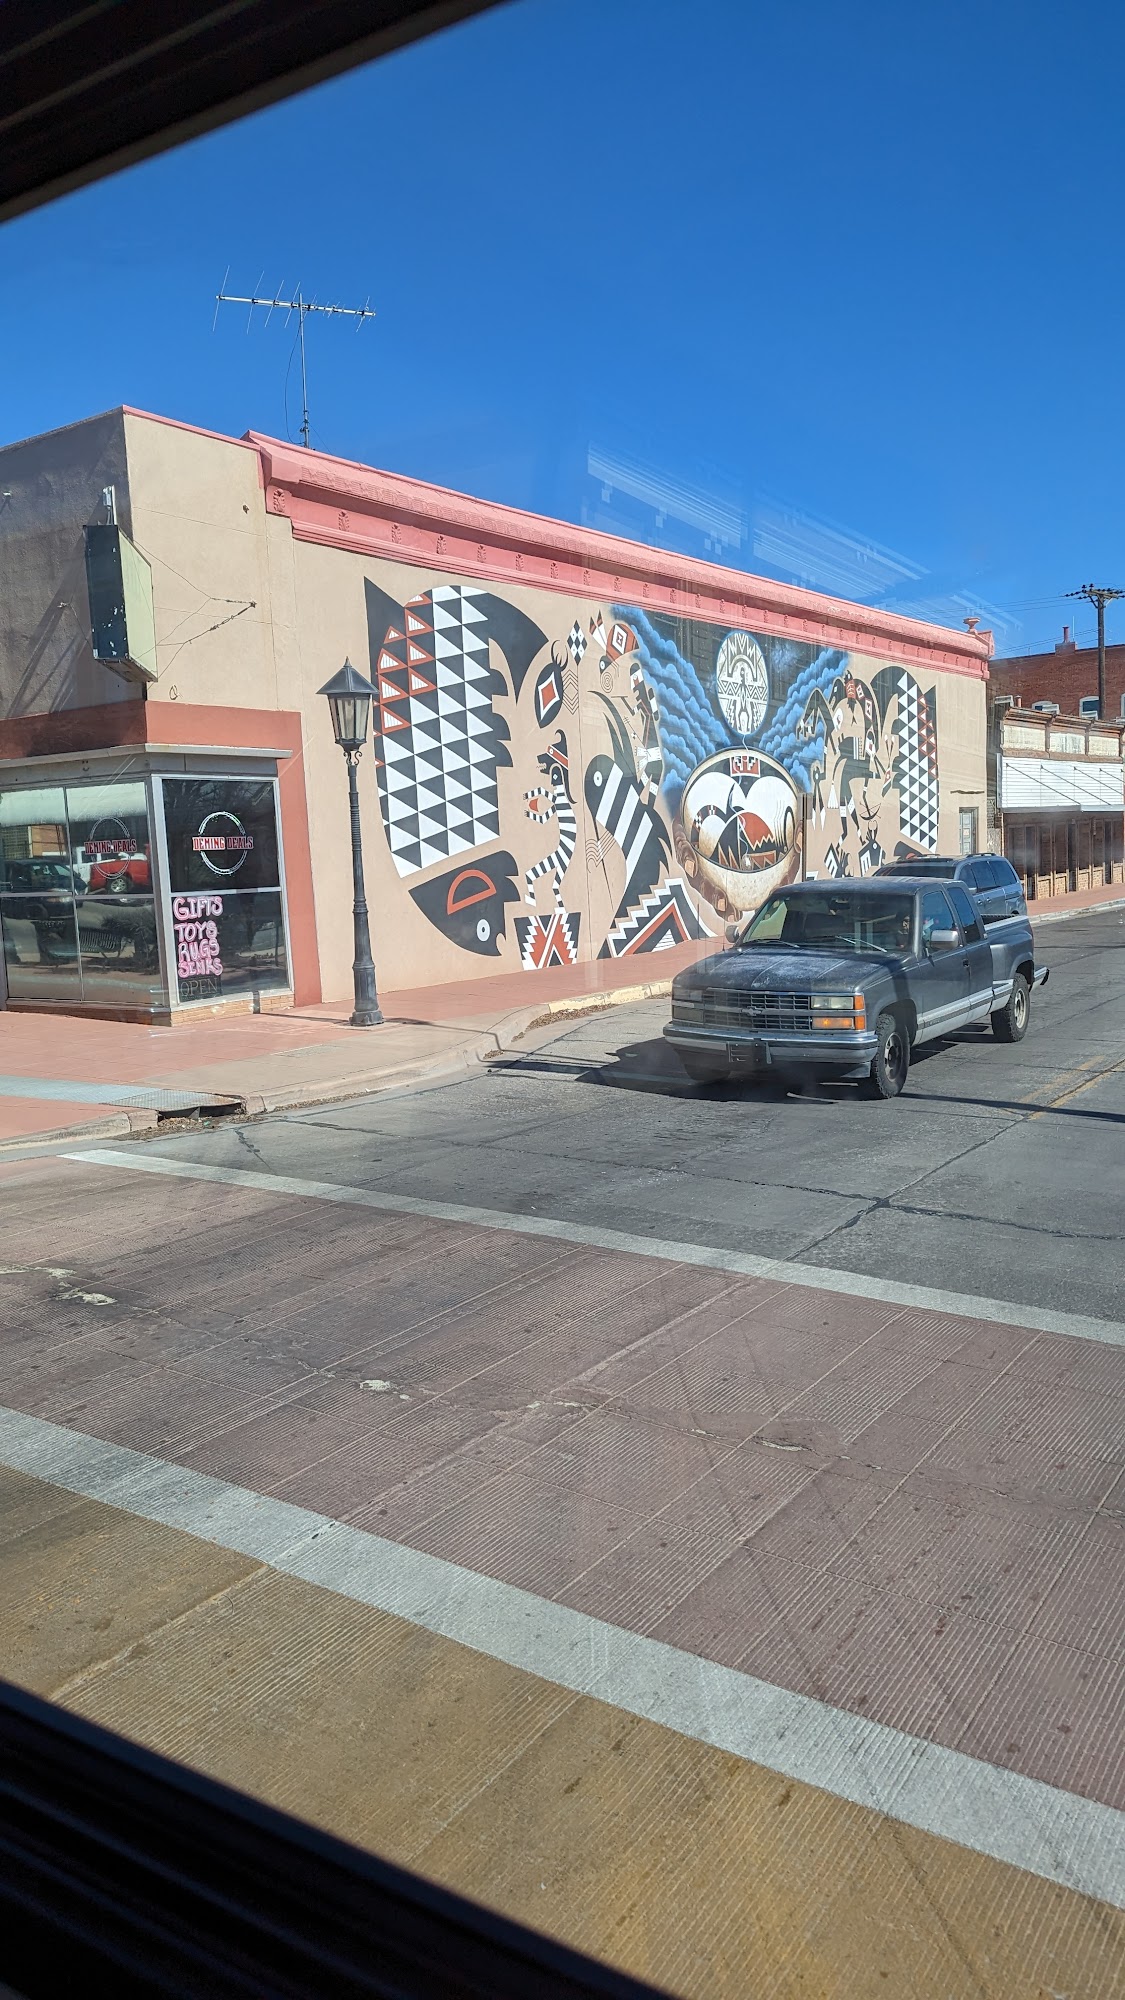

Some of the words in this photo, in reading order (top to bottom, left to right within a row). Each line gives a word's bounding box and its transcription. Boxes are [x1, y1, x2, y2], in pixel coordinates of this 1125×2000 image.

[84, 841, 111, 855] DEMING
[112, 839, 137, 853] DEALS
[192, 837, 225, 850] DEMING
[226, 836, 254, 849] DEALS
[173, 896, 223, 920] GIFTS
[174, 920, 218, 942] TOYS
[178, 938, 220, 961] RUGS
[180, 978, 217, 997] OPEN
